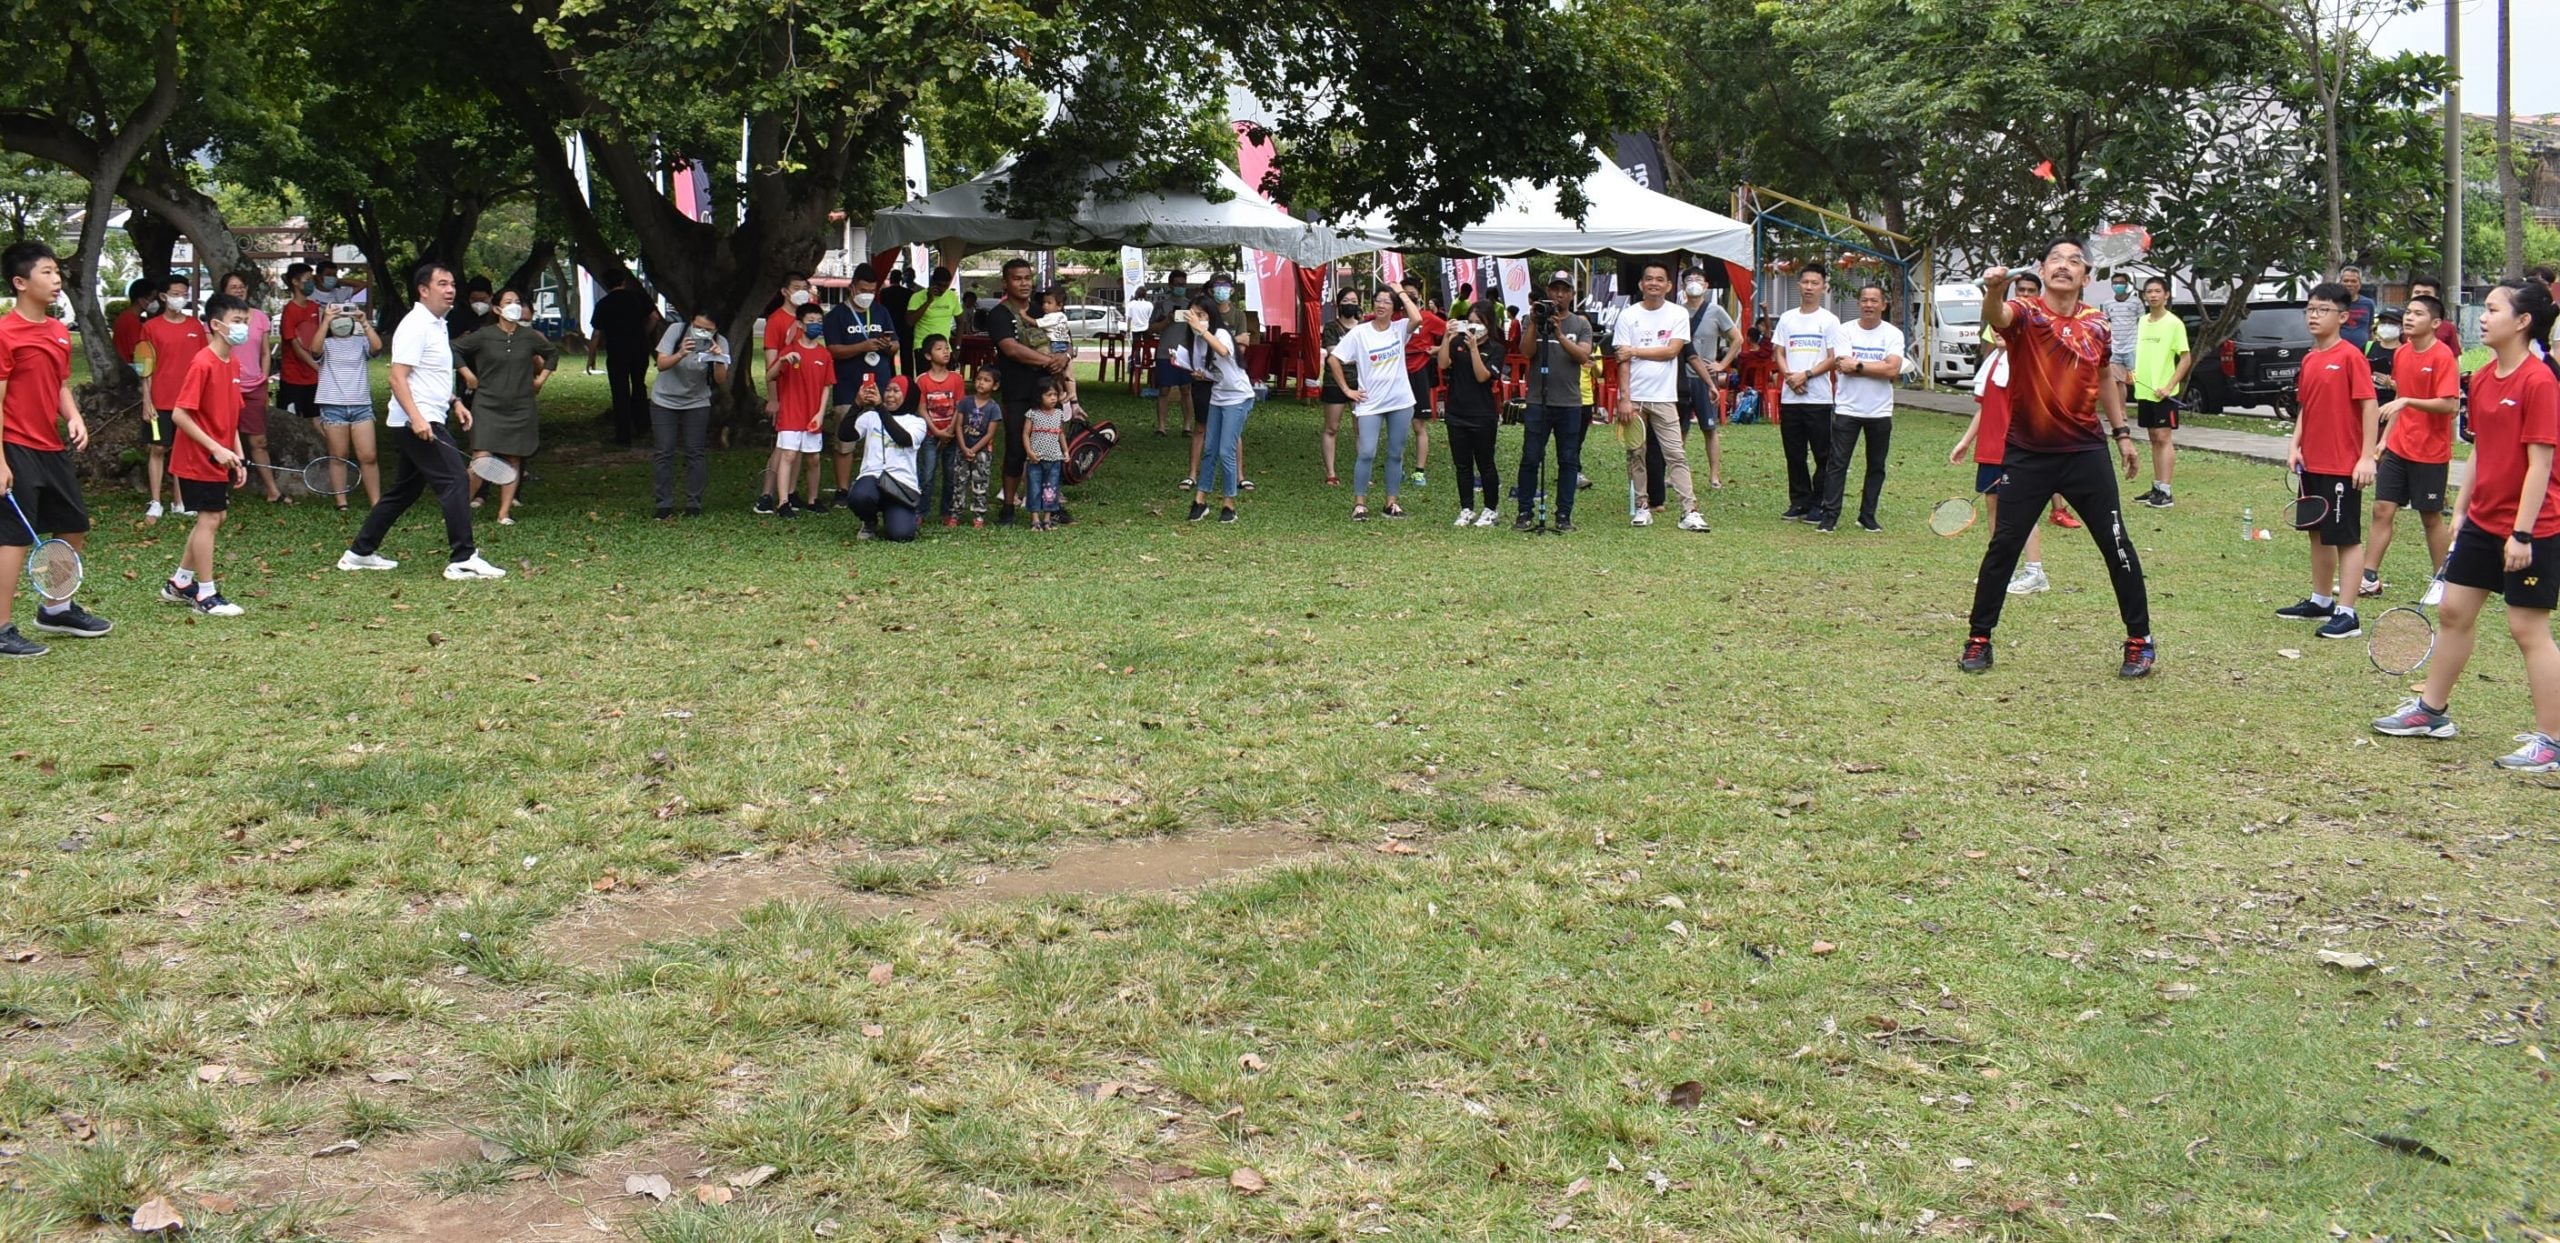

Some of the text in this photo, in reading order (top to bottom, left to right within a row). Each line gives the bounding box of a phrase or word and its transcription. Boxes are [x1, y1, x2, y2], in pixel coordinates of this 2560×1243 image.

[847, 324, 882, 334] addas
[1795, 339, 1822, 348] PENANG
[1377, 345, 1401, 361] PENAN
[1856, 351, 1883, 361] PENANG
[2333, 481, 2345, 524] Champion
